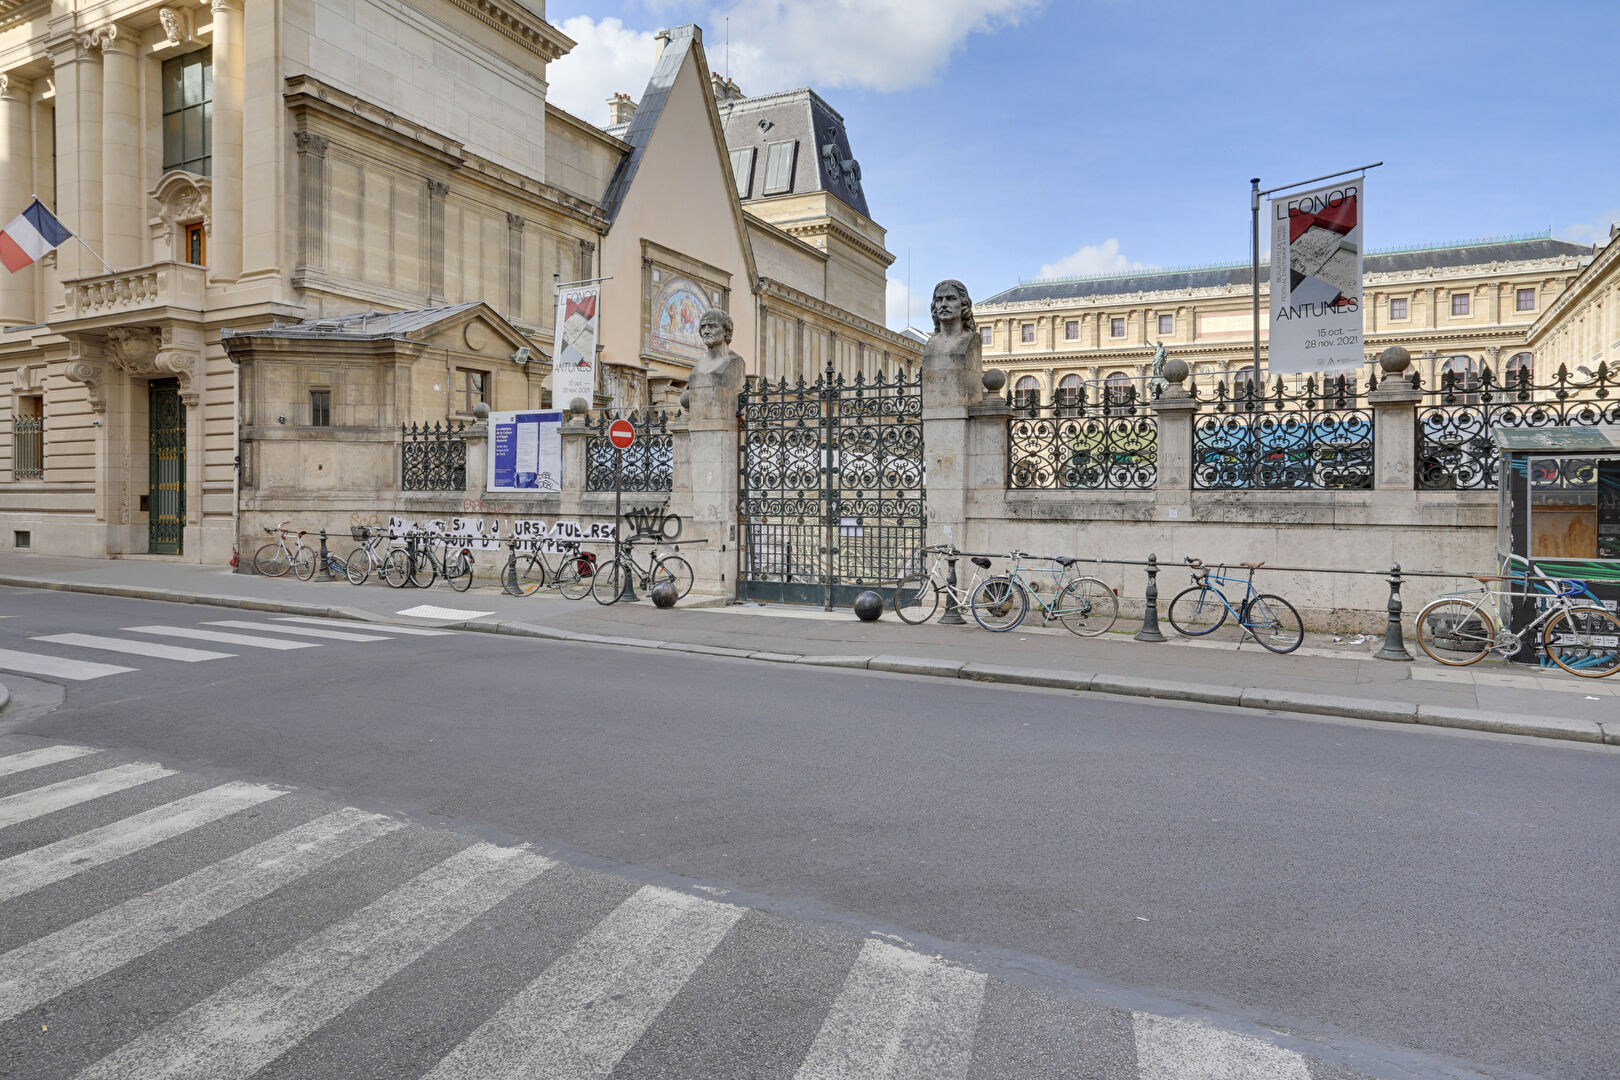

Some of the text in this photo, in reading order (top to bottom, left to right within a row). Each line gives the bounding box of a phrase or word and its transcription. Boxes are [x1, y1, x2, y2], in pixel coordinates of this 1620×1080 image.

[1276, 186, 1358, 220] LEONOR
[560, 289, 598, 306] LEONOR
[1276, 296, 1359, 322] ANTUNES
[1317, 329, 1327, 337] 15
[1328, 328, 1345, 336] oct.
[1304, 340, 1317, 349] 28
[1336, 335, 1358, 346] 2021
[554, 361, 593, 374] ANTUNES
